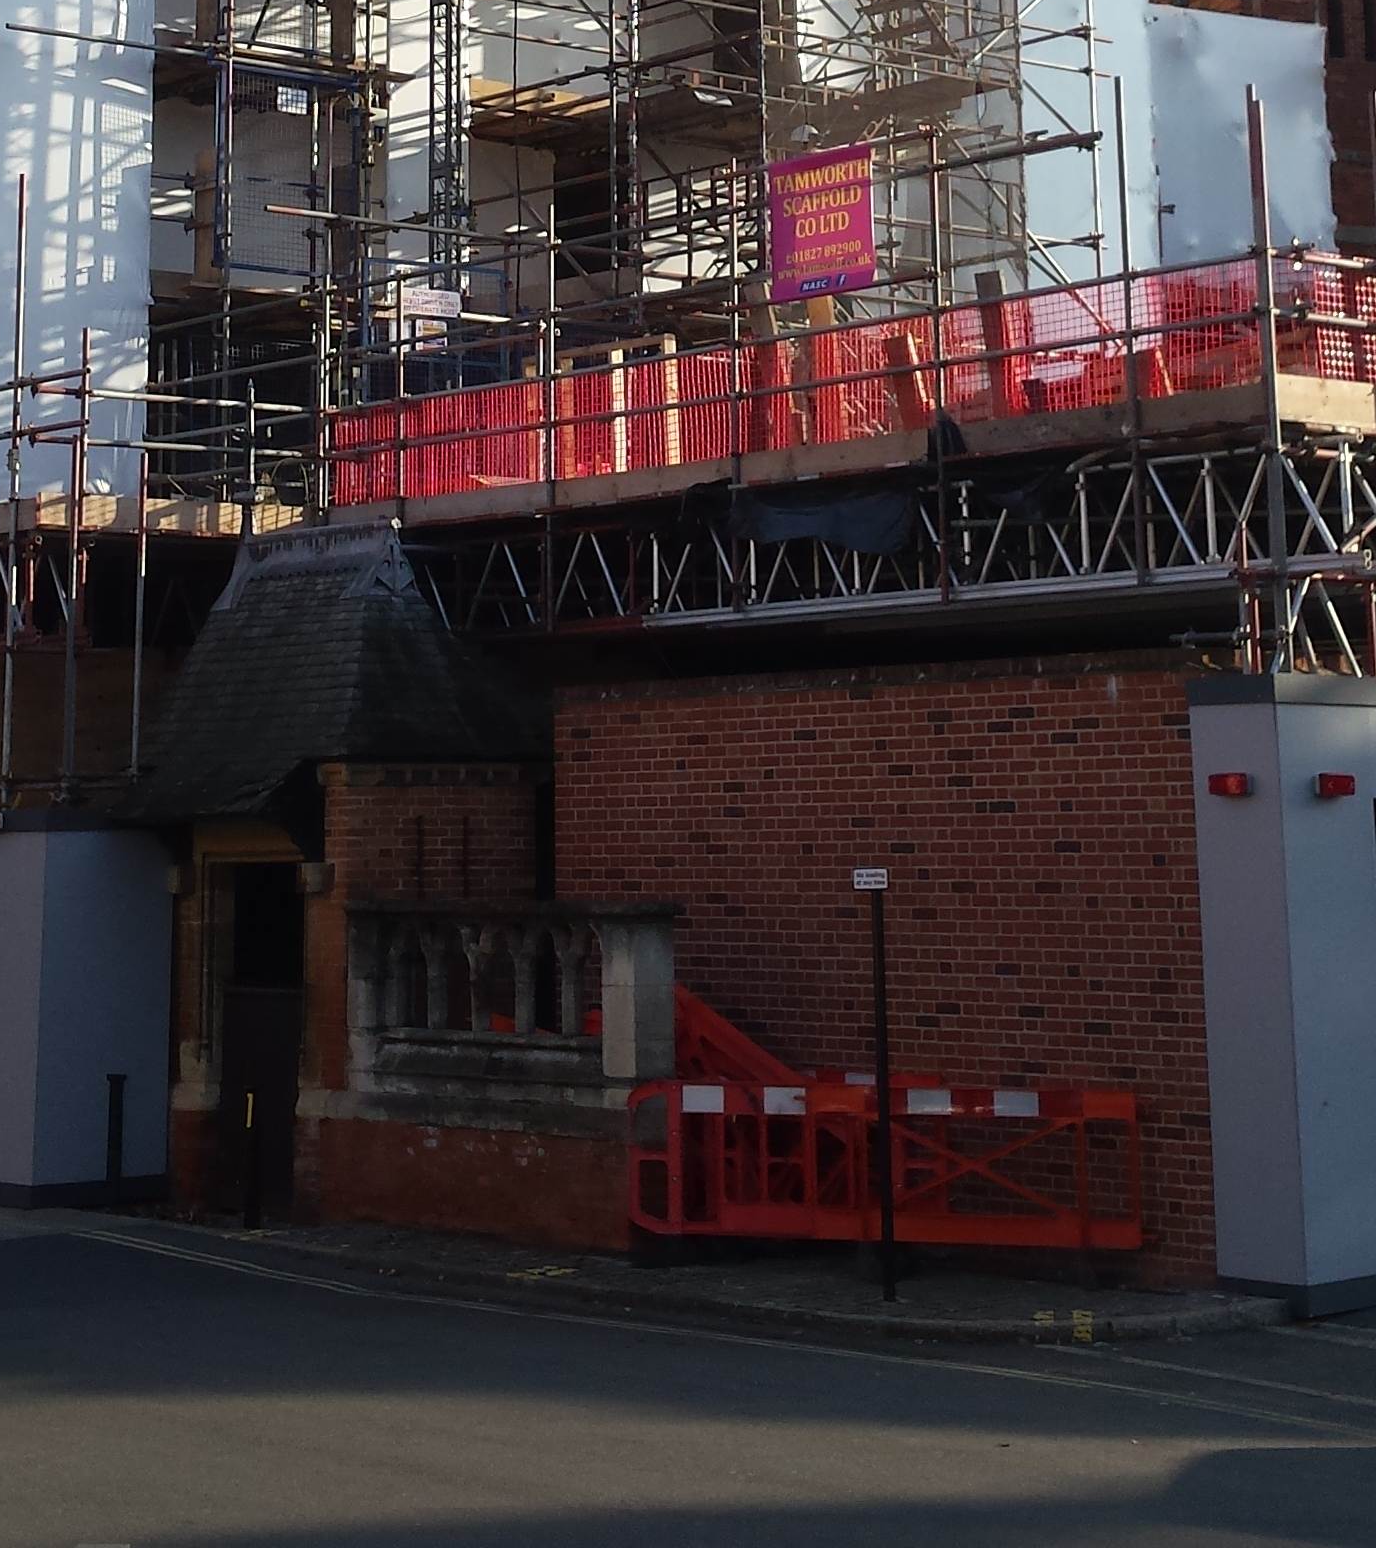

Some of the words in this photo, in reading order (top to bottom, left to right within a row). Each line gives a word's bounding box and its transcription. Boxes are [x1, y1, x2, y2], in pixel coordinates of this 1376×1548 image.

[773, 158, 869, 195] TAMWORTH
[783, 185, 862, 218] SCAFFOLD
[795, 217, 816, 238] CO
[820, 211, 850, 234] LTD
